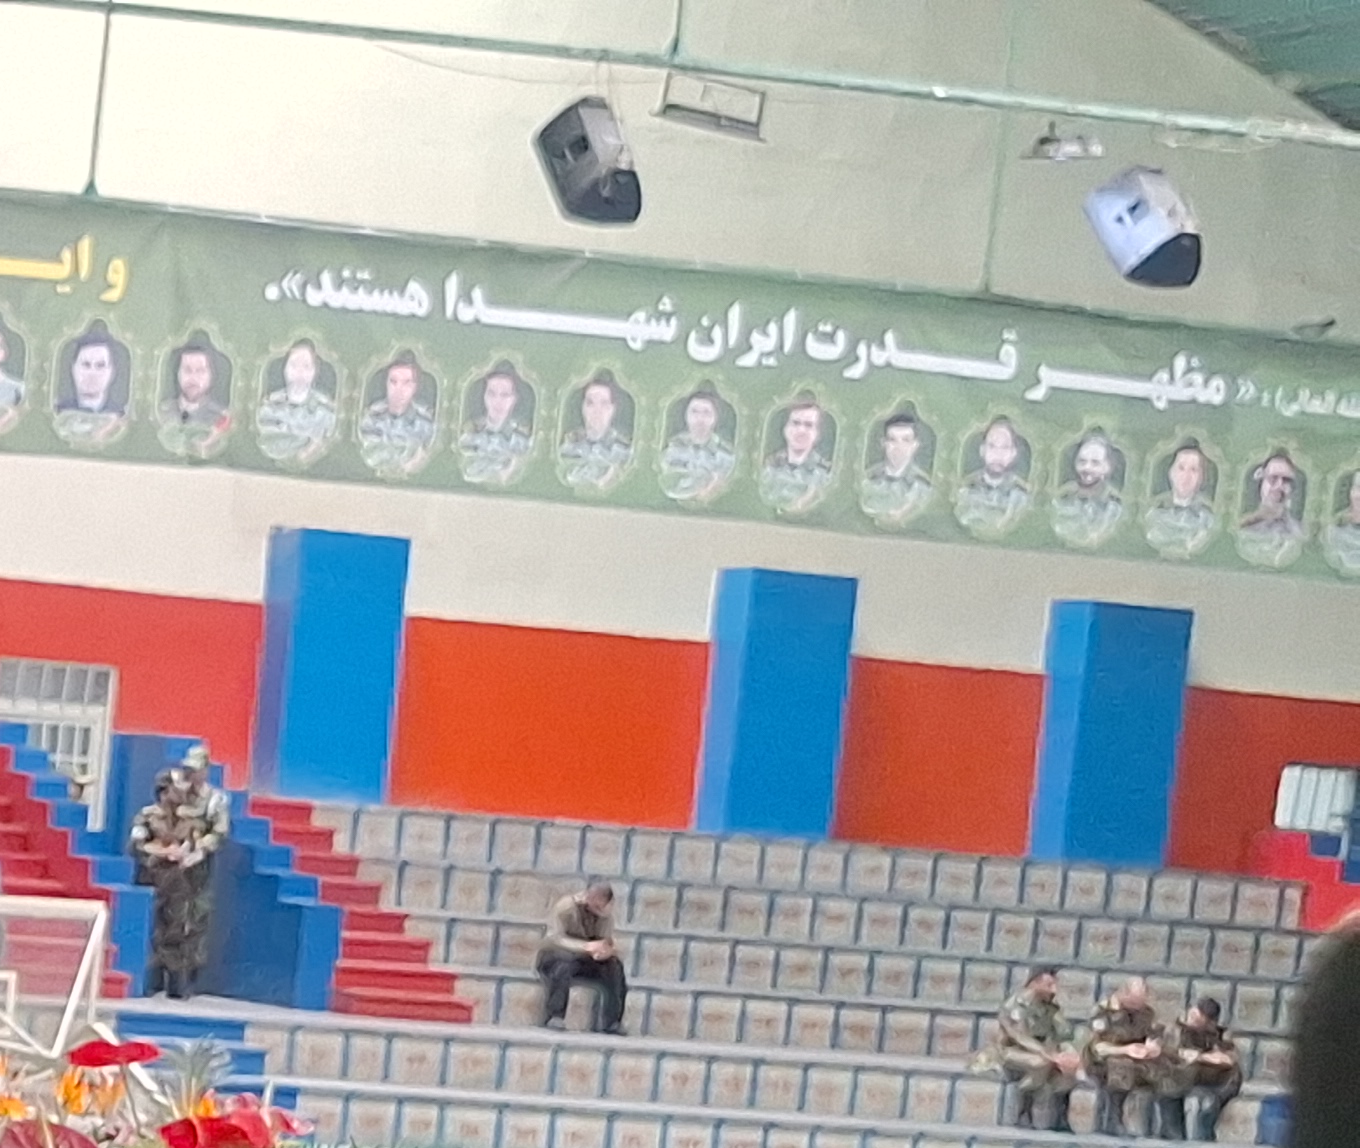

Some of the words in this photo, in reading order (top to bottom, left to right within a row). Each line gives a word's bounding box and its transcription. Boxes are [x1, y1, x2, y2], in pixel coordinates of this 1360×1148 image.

[99, 258, 127, 303] و
[444, 269, 678, 352] شهدا
[687, 299, 798, 368] ایران
[805, 319, 1018, 380] قدرت
